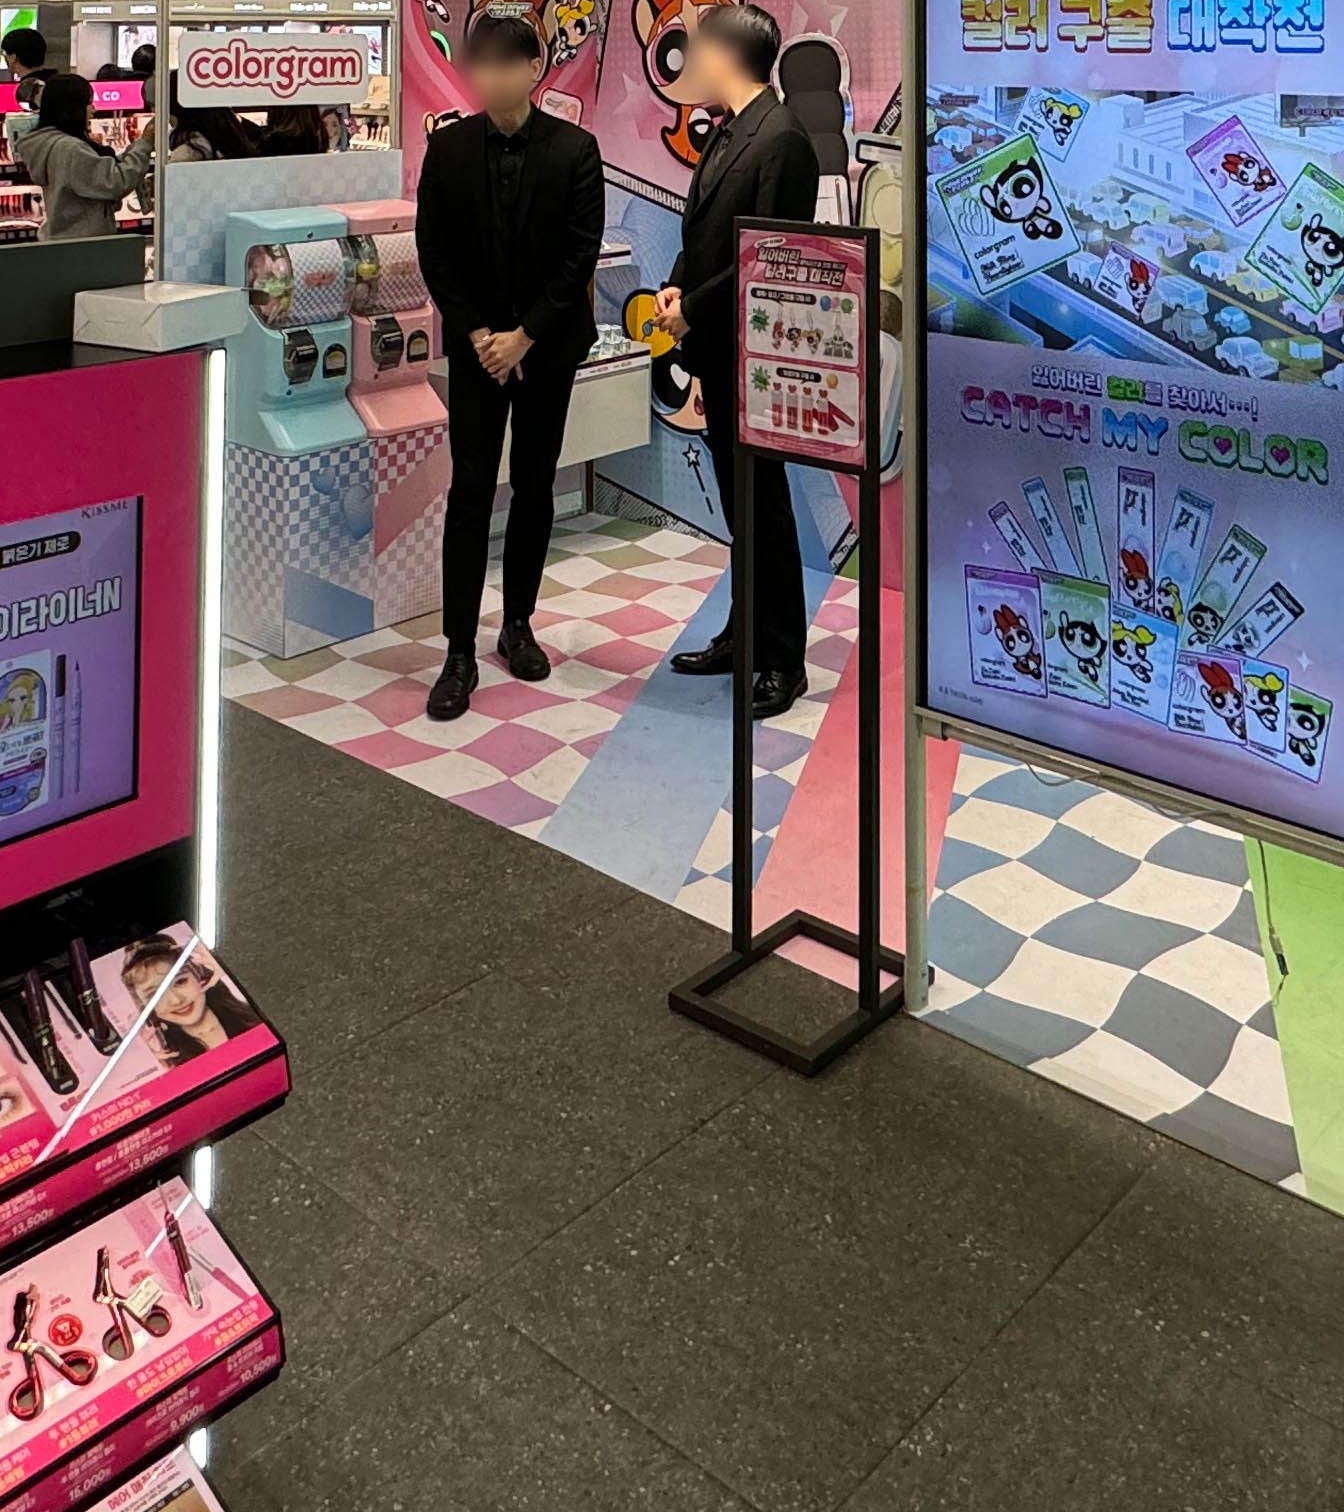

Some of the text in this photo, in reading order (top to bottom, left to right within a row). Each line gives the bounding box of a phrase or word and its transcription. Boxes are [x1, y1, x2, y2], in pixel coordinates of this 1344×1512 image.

[194, 47, 356, 90] colorgram
[1032, 364, 1103, 398] 잃어버린
[960, 384, 1329, 485] CATCH MY COLOR
[81, 500, 128, 519] KISSME
